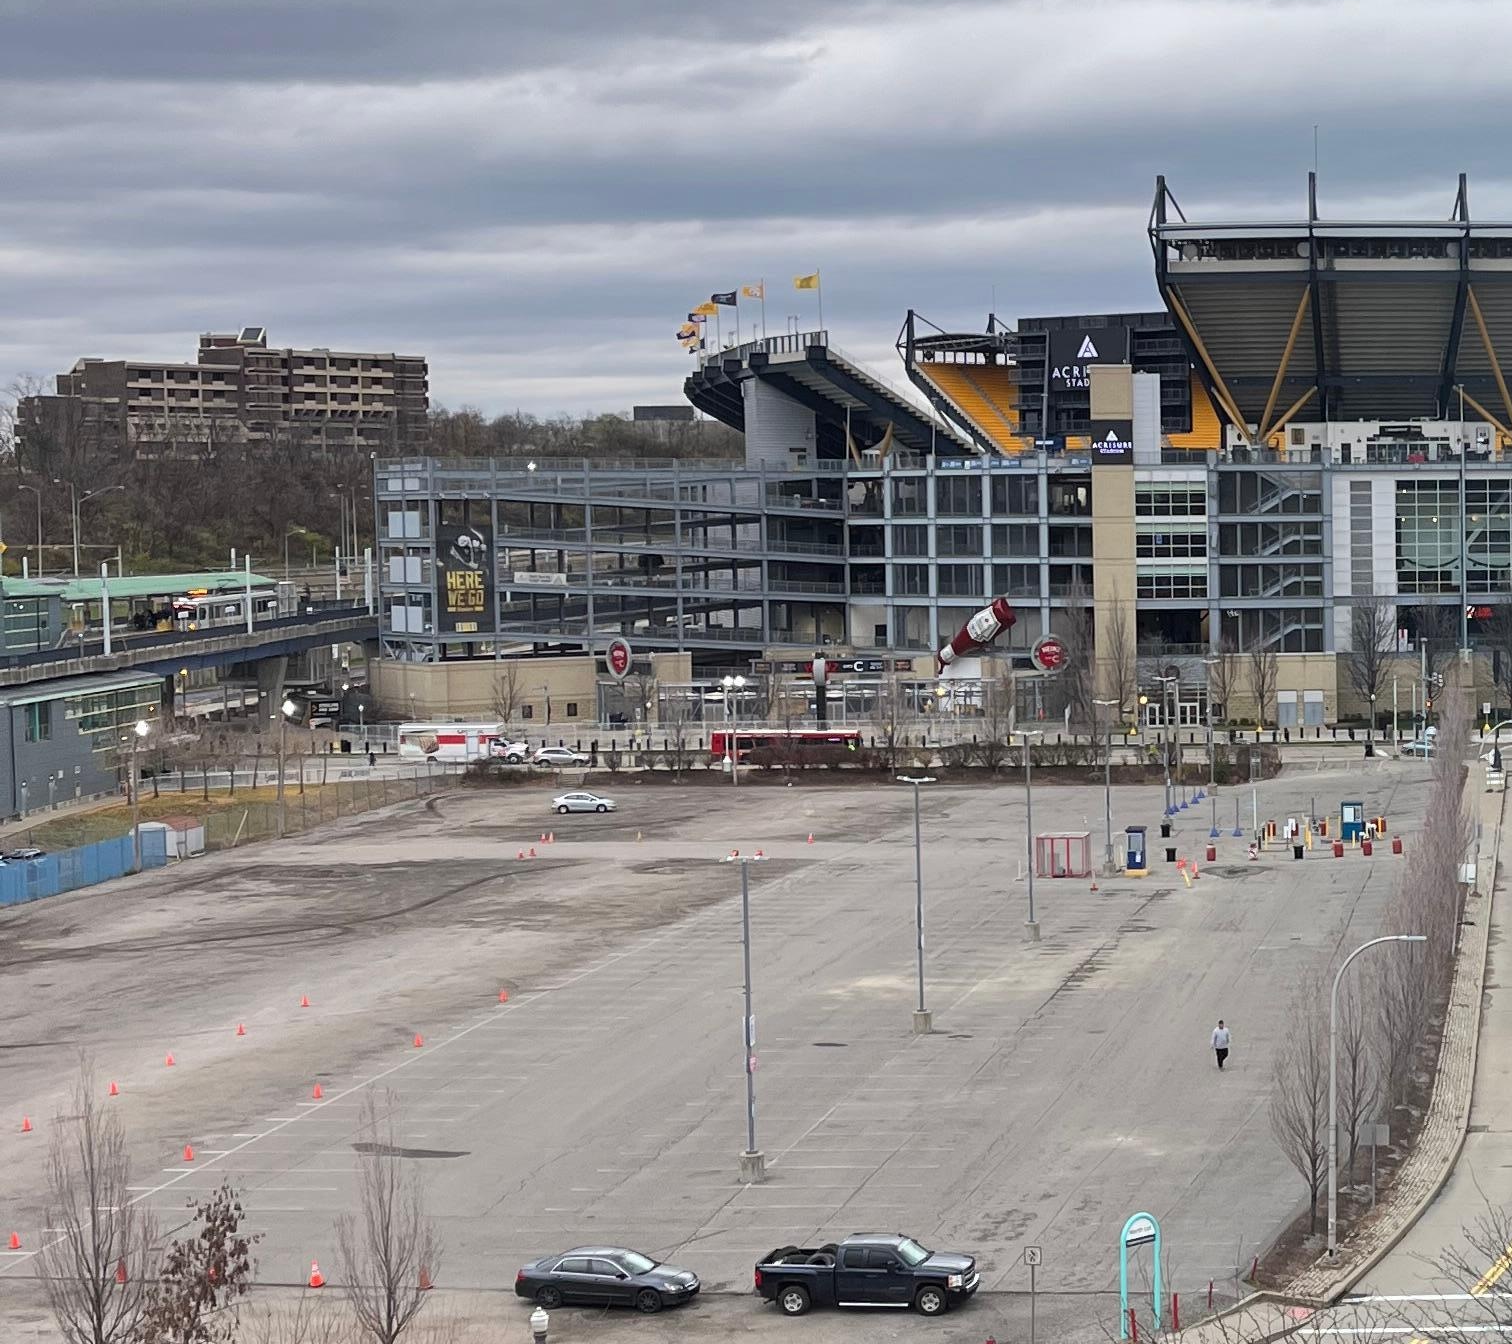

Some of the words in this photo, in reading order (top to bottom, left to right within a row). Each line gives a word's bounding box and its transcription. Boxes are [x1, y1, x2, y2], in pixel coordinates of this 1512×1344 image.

[447, 570, 485, 589] HERE
[448, 590, 465, 605] WE
[468, 590, 484, 605] GO
[854, 661, 864, 671] C
